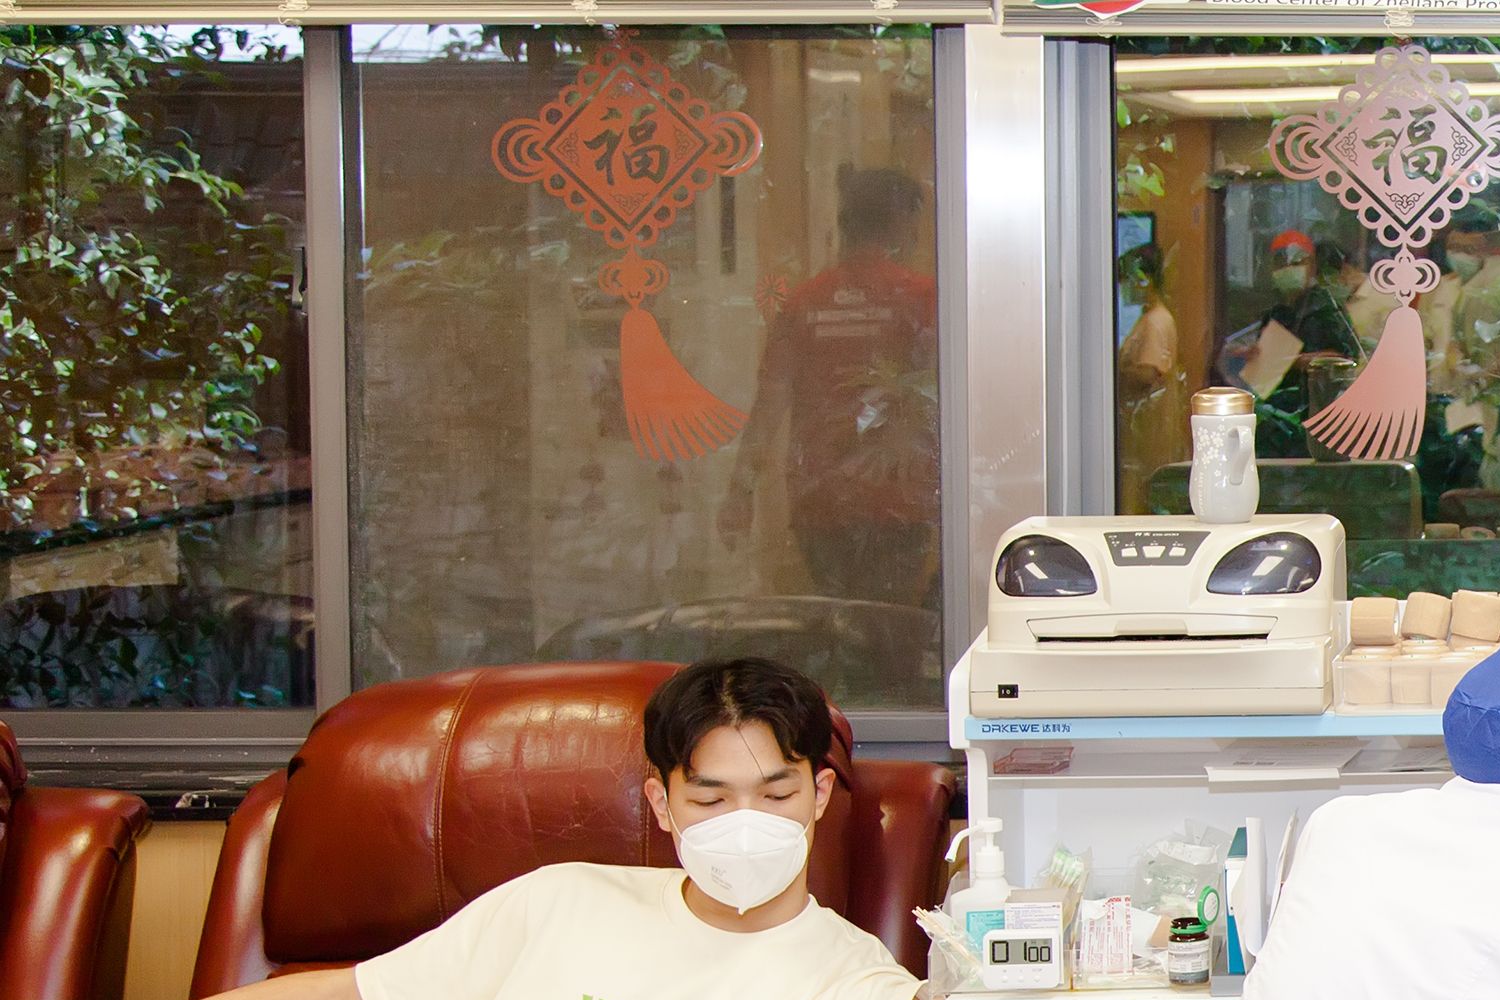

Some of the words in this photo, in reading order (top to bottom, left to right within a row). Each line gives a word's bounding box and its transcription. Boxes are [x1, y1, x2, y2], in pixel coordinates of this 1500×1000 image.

[583, 104, 670, 186] 福
[1361, 104, 1448, 187] 福
[981, 723, 1040, 733] DAKEWE
